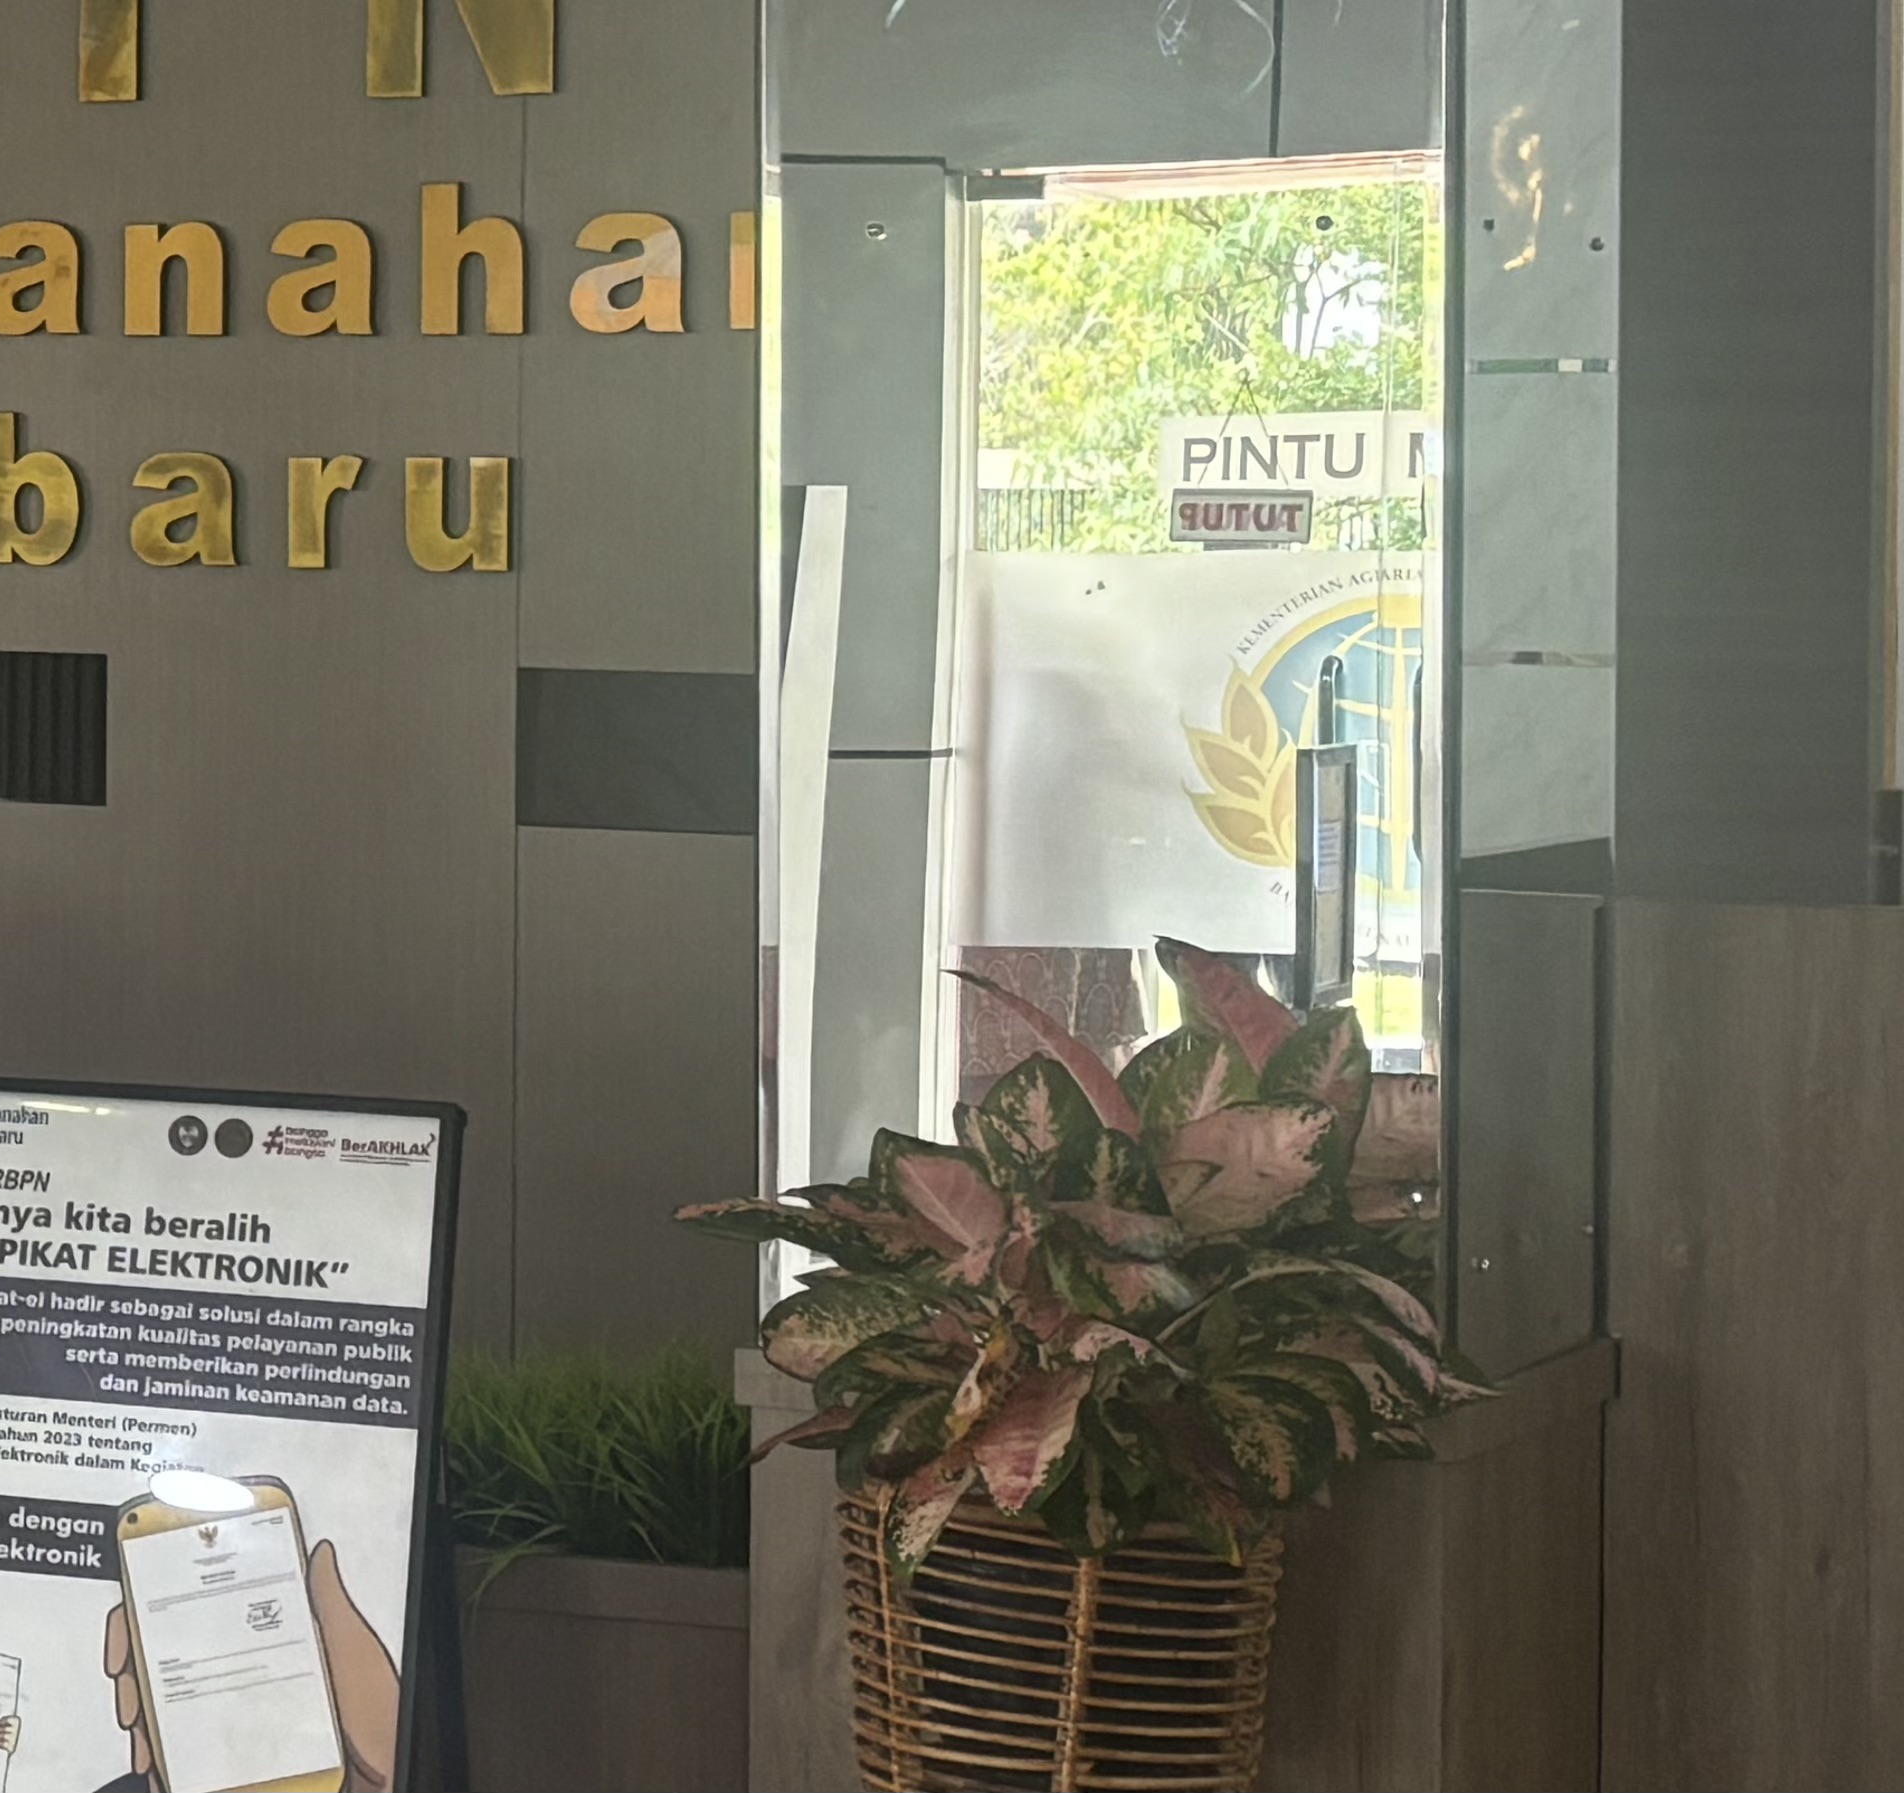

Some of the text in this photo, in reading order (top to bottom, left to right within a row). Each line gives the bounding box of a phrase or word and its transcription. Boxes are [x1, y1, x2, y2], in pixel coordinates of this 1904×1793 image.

[1182, 433, 1366, 482] PINTU
[1236, 577, 1343, 655] KEMENTERIAN
[65, 1201, 131, 1234] kita
[145, 1206, 271, 1243] beralih
[107, 1246, 349, 1288] ELEKTRONIK”
[51, 1292, 105, 1313] hadir
[109, 1297, 193, 1321] sebagai
[199, 1305, 260, 1324] solusi
[266, 1309, 332, 1330] dalam
[339, 1318, 414, 1338] rangka
[0, 1316, 412, 1363] peningkatan kualitas pelayanan publik
[65, 1346, 410, 1390] serta memberikan perlindungan
[100, 1373, 408, 1415] dan jaminan keamanan data.
[43, 1430, 82, 1447] 2023
[88, 1436, 153, 1455] tentang
[53, 1411, 116, 1429] Menteri
[122, 1416, 197, 1437] (Permen)
[74, 1453, 125, 1470] dalam
[8, 1507, 105, 1538] dengan
